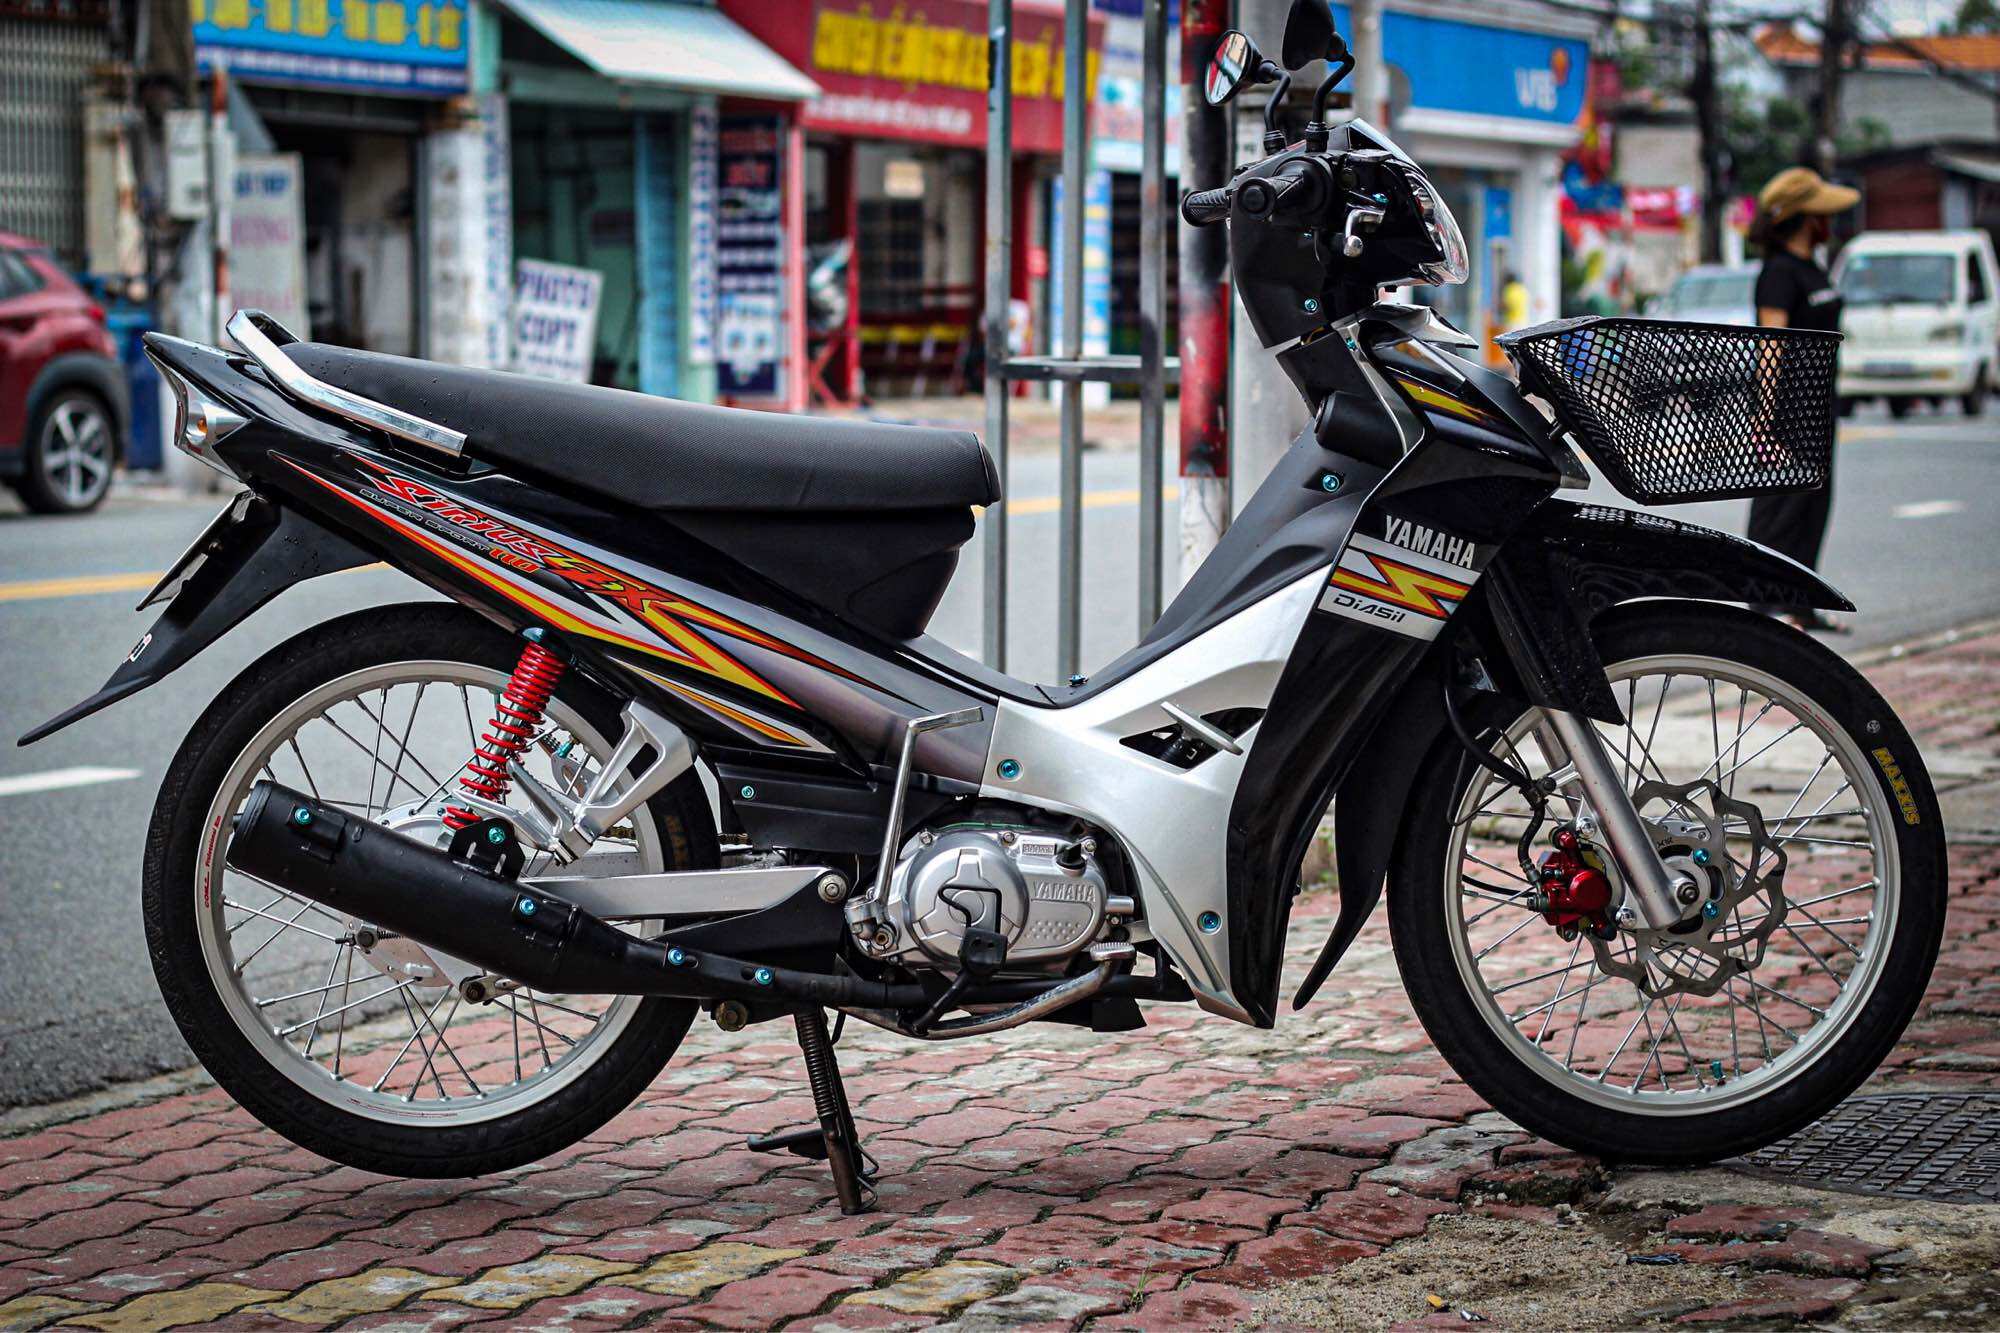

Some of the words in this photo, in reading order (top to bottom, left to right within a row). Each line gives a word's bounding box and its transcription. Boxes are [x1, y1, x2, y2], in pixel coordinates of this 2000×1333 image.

[513, 267, 591, 308] PHOTO
[356, 470, 567, 563] Sirius
[359, 488, 424, 522] SUPER
[425, 519, 491, 551] SPORT
[488, 547, 541, 574] 110
[1384, 514, 1476, 569] YAMAHA
[1872, 747, 1921, 825] MAXXIS
[1032, 880, 1097, 903] YAMAHA
